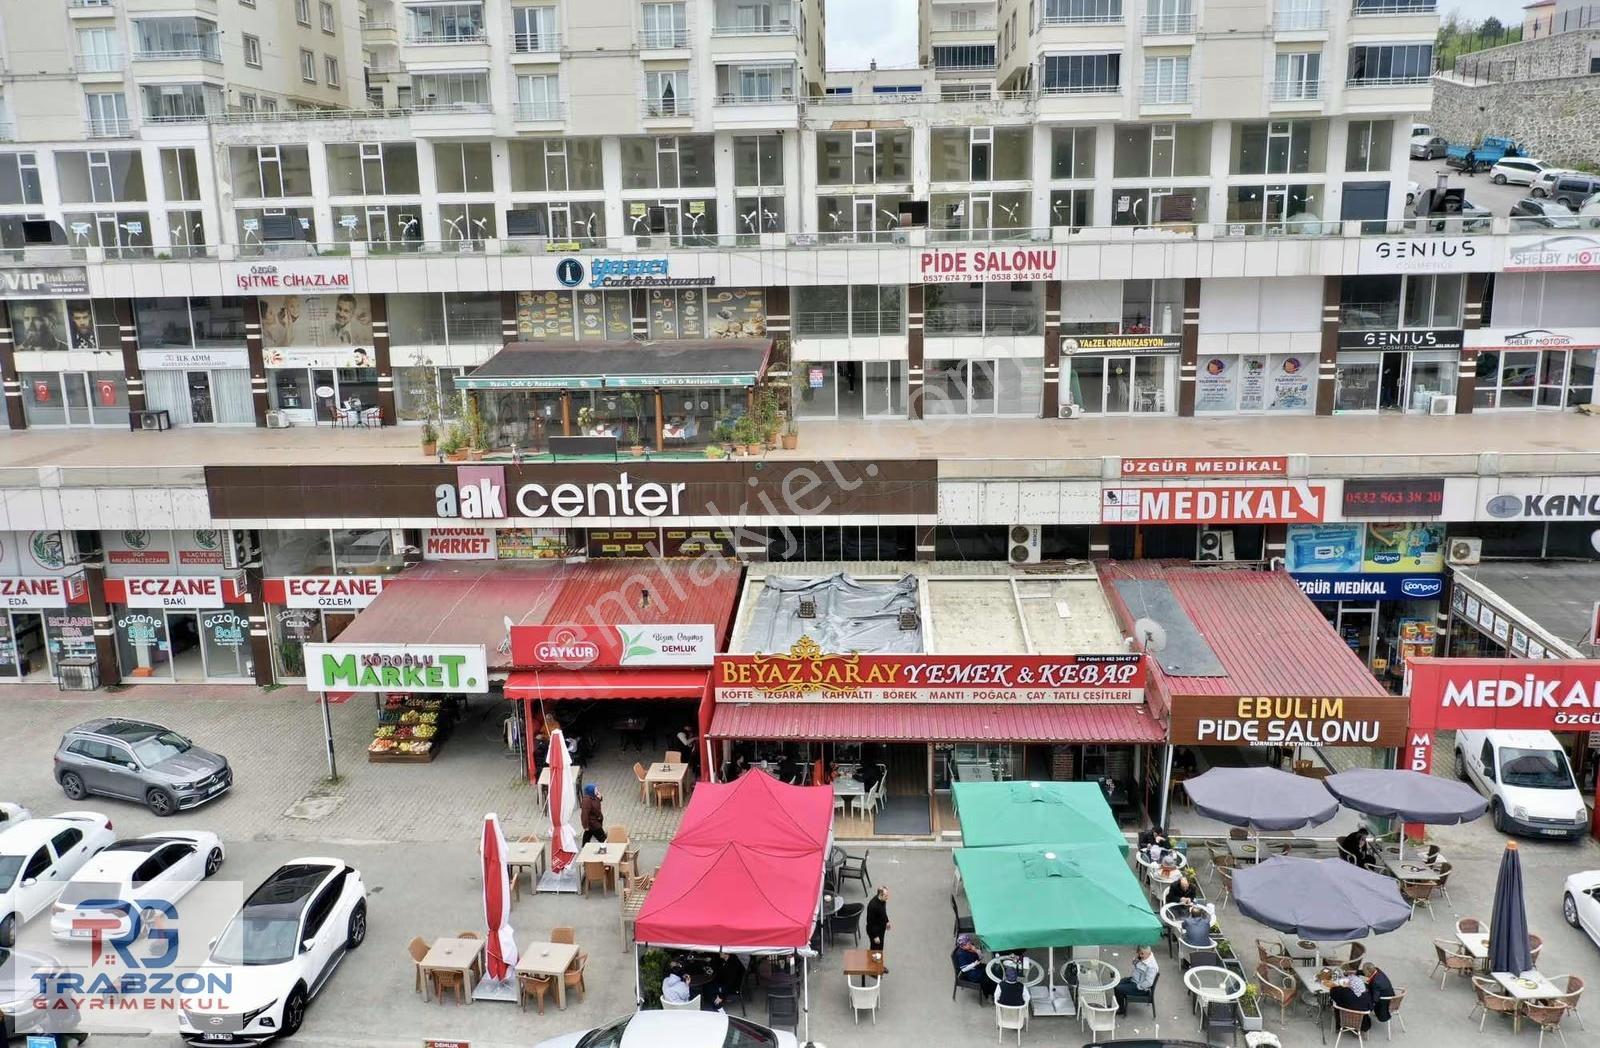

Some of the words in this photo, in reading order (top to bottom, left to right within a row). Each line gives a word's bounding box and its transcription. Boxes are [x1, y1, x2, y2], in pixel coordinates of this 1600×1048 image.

[1376, 240, 1475, 258] GENIUS
[921, 248, 966, 272] PİDE
[974, 251, 1056, 272] SALONU
[1514, 252, 1560, 265] SHELBY
[250, 265, 278, 274] ÖZGÜR
[236, 273, 280, 290] İŞİTME
[282, 272, 349, 287] CİHAZLARI
[1364, 332, 1436, 345] GENIUS
[1123, 459, 1187, 473] ÖZGÜR
[1195, 458, 1282, 472] MEDİKAL
[516, 472, 685, 517] center
[1142, 490, 1298, 520] MEDİKAL
[427, 539, 490, 554] MARKET
[129, 579, 216, 595] ECZANE
[289, 579, 378, 596] ECZANE
[1295, 578, 1330, 594] ZGÜR
[1334, 579, 1387, 594] MEDİKAL
[8, 598, 28, 606] EDA
[164, 595, 186, 605] BAKİ
[318, 597, 352, 605] ÖZLEM
[118, 614, 162, 628] eczane
[204, 614, 248, 628] eczane
[361, 653, 433, 667] KÖROĞLU
[539, 646, 595, 660] ÇAYKUR
[721, 661, 803, 683] BEYAZ
[810, 661, 901, 683] SARAY
[904, 663, 1014, 688] YEMEK
[1017, 667, 1035, 683] &
[1038, 664, 1138, 688] KEBAP
[721, 690, 753, 699] KÖFTE
[822, 691, 873, 699] KAHVALTI
[883, 689, 917, 699] BÖREK
[929, 691, 964, 700] MANTI
[973, 690, 1017, 701] POĞAÇA
[1026, 691, 1046, 701] ÇAY
[1053, 691, 1080, 700] TATLI
[1238, 697, 1343, 719] EBULİM
[1197, 720, 1258, 742] PİDE
[1267, 720, 1380, 743] SALONU
